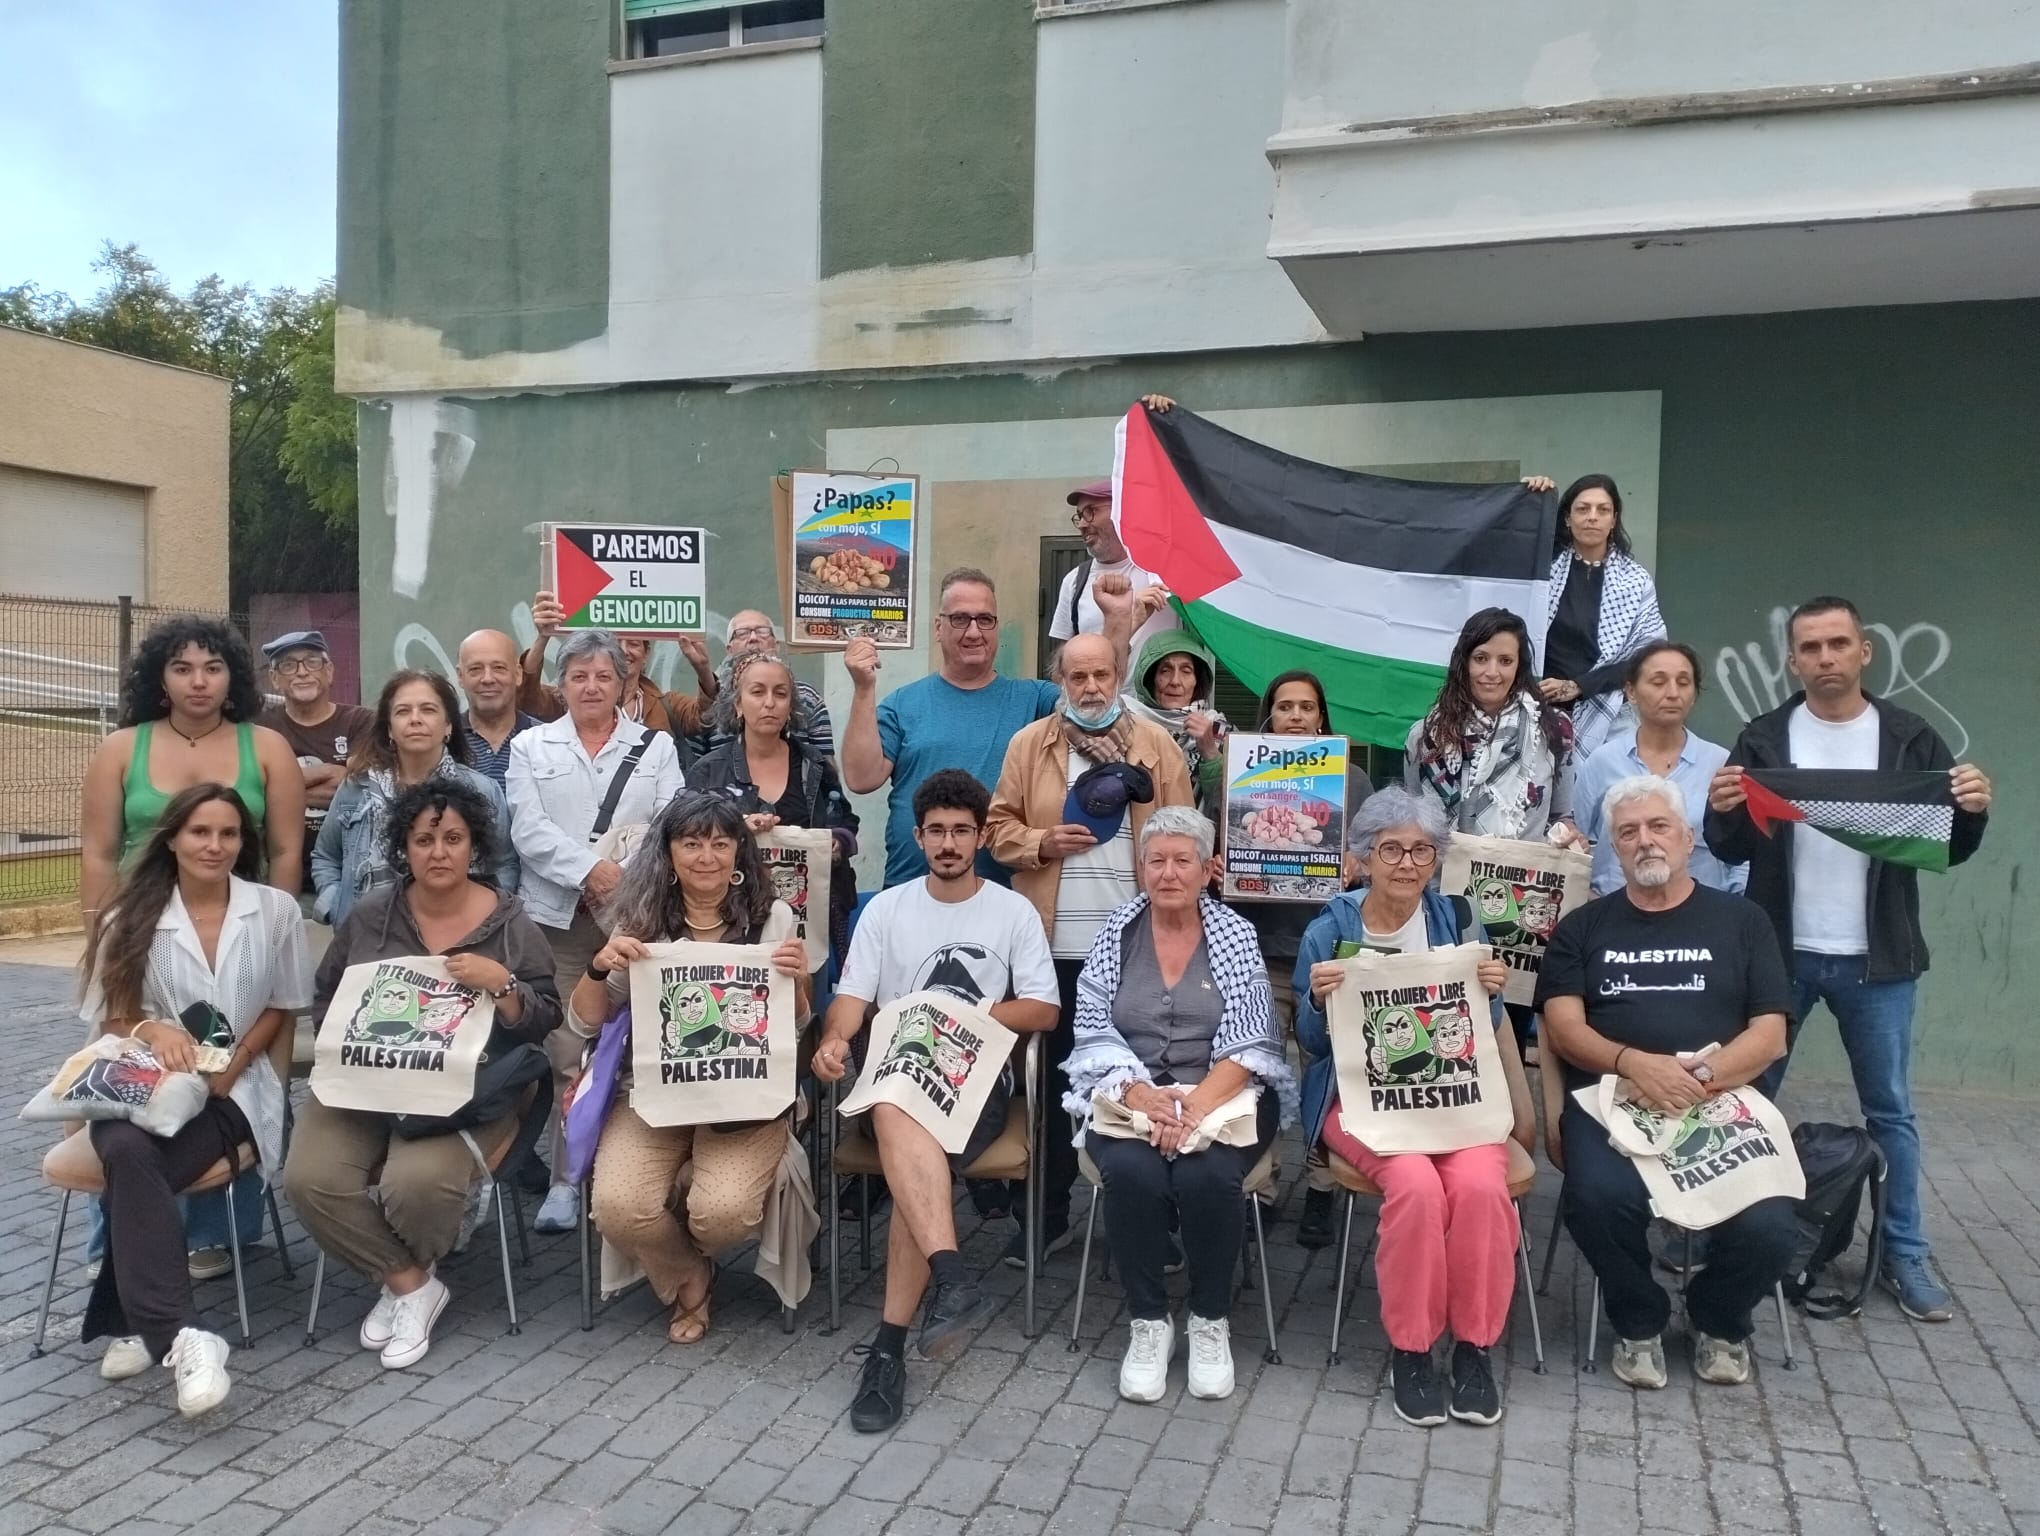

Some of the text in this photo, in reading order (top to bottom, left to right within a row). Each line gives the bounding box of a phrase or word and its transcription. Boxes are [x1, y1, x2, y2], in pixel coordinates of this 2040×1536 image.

[813, 488, 896, 514] ¿Papas?
[818, 521, 881, 536] con mojo, SÍ
[592, 533, 693, 560] PAREMOS
[630, 570, 648, 588] EL
[588, 598, 696, 624] GENOCIDIO
[798, 594, 830, 605] BOICOT
[848, 598, 868, 606] PAPAS
[878, 598, 908, 608] ISRAEL
[800, 606, 904, 620] CONSUME PRODUCTOS CANARIOS
[1245, 744, 1330, 770] ¿Papas?
[1250, 777, 1314, 792] con mojo, SÍ
[1250, 792, 1266, 800] con
[1302, 802, 1330, 826] NO
[780, 848, 807, 862] LIBRE
[1228, 850, 1260, 860] BOICOT
[1310, 854, 1340, 864] ISRAEL
[1230, 862, 1337, 877] CONSUME PRODUCTOS CANARIOS
[1483, 862, 1496, 878] TE
[1536, 871, 1566, 890] LIBRE
[1604, 948, 1714, 964] PALESTINA
[390, 964, 406, 980] TE
[446, 982, 482, 1002] LIBRE
[674, 966, 688, 983] TE
[736, 966, 769, 984] LIBRE
[1600, 973, 1706, 996] فلسطين
[1374, 989, 1390, 1008] TE
[1438, 981, 1466, 1002] LIBRE
[952, 1023, 984, 1053] LIBRE
[340, 1044, 444, 1072] PALESTINA
[660, 1057, 768, 1085] PALESTINA
[872, 1059, 956, 1118] PALESTINA
[1370, 1081, 1483, 1112] PALESTINA
[1670, 1136, 1780, 1193] PALESTINA
